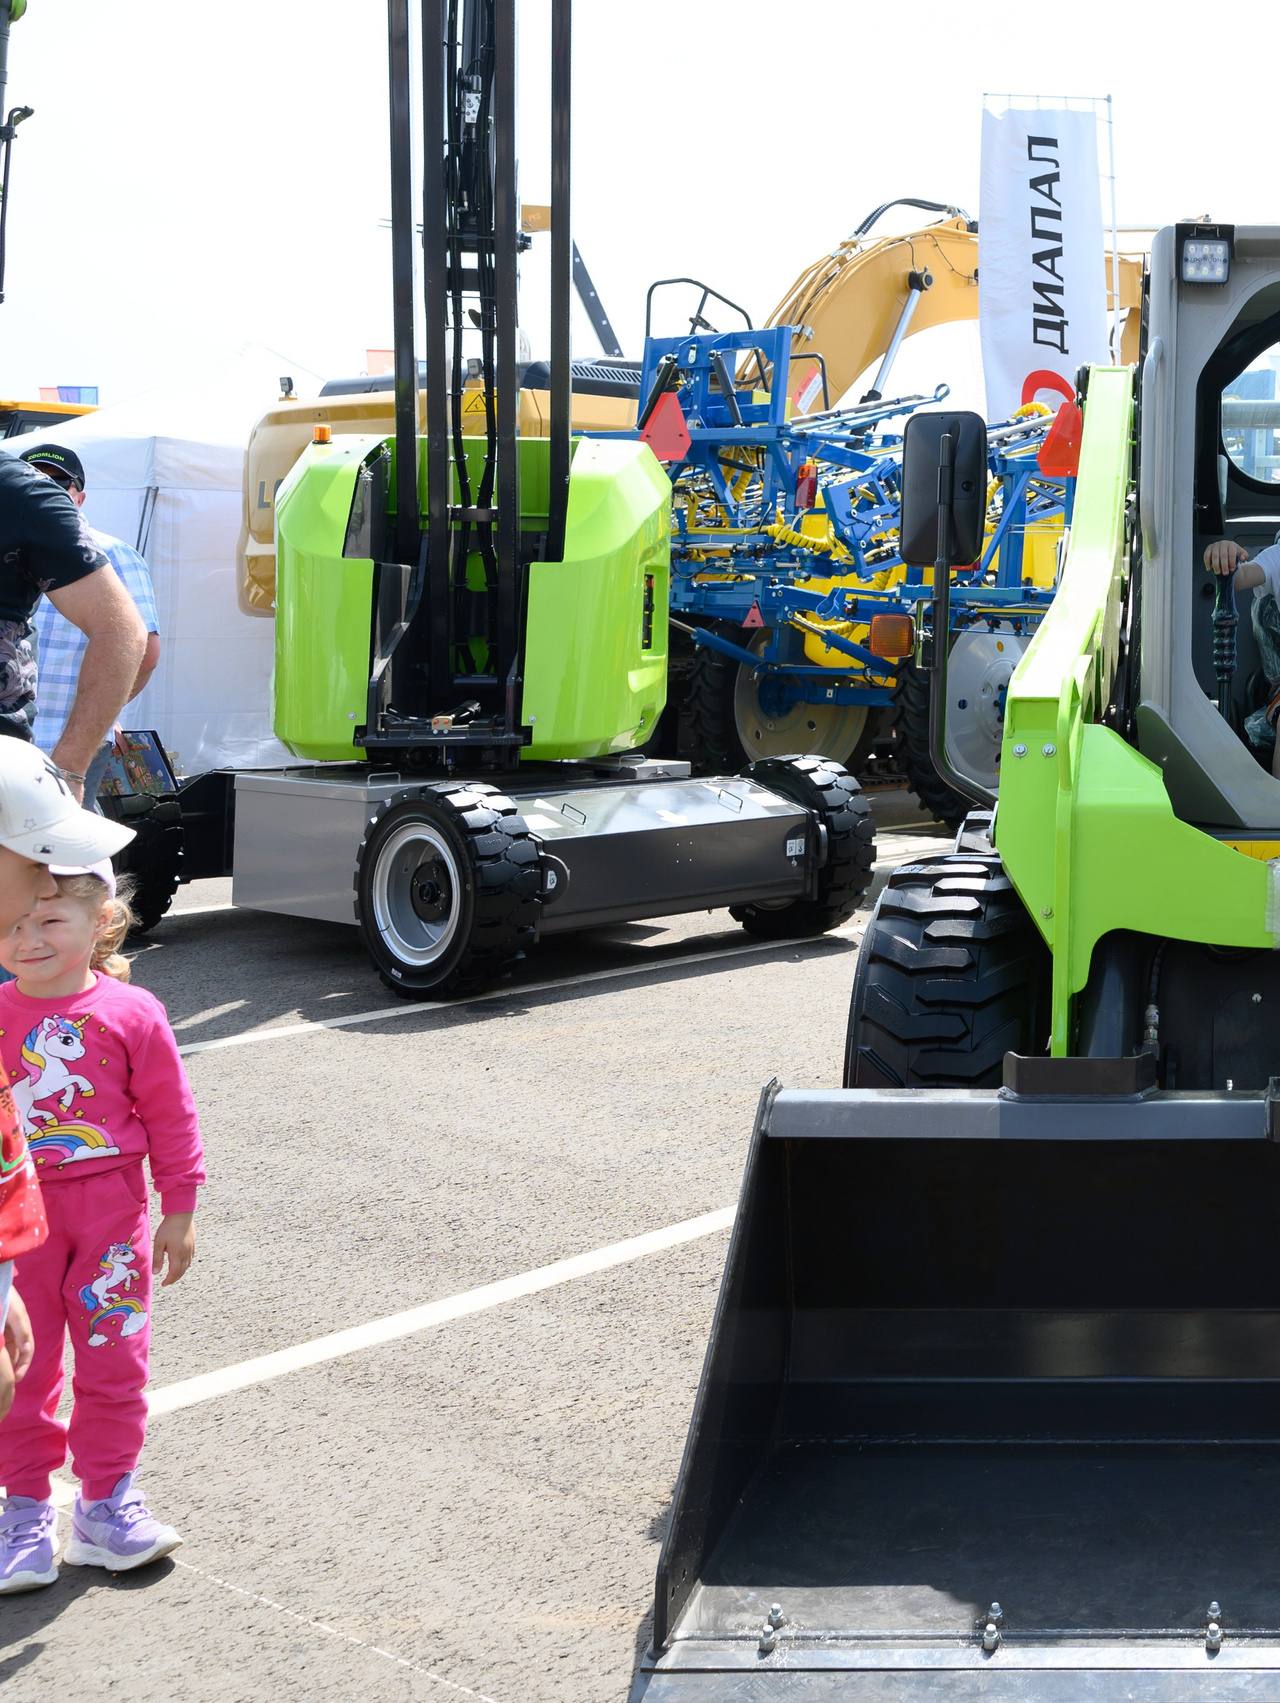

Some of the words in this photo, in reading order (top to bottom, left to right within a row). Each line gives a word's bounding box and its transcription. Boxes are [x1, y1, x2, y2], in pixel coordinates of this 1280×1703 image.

[1027, 135, 1069, 354] ДИАПАЛ
[27, 452, 65, 462] ZOOMLION
[258, 479, 284, 509] L
